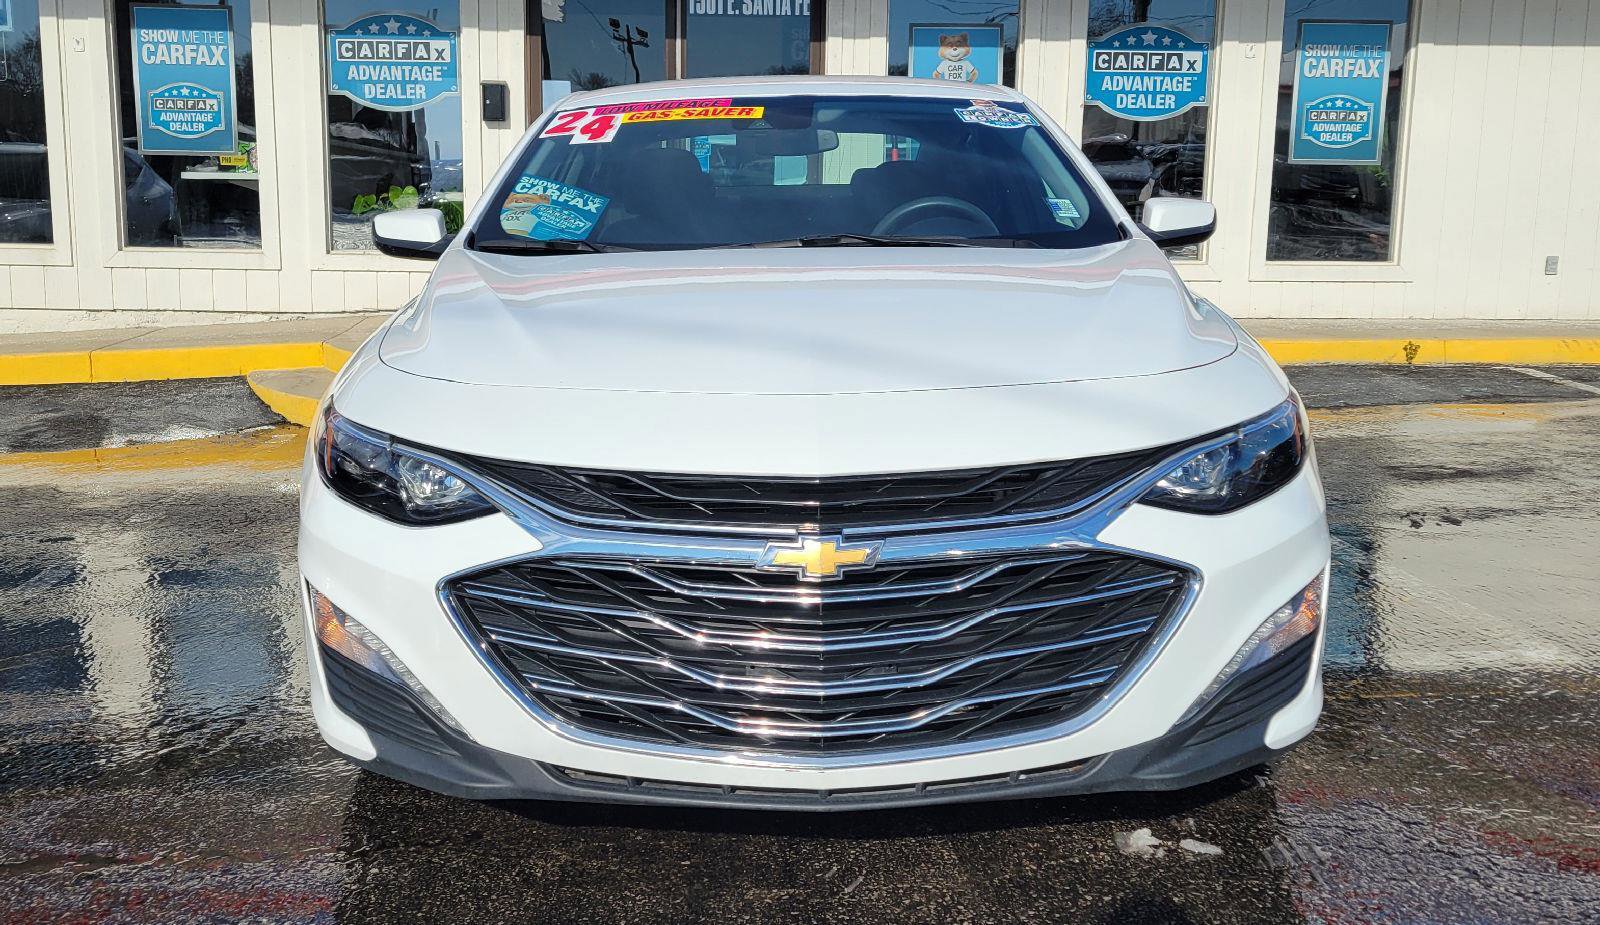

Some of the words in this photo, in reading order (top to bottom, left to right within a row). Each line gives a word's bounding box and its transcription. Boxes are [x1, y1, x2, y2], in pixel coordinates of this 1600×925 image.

[727, 0, 739, 15] E.
[742, 0, 792, 15] SANTA
[794, 0, 811, 16] FE
[140, 29, 178, 43] SHOW
[182, 32, 200, 43] ME
[202, 31, 224, 44] THE
[142, 43, 227, 66] CARFAX
[339, 42, 447, 62] CARFAX
[1305, 44, 1340, 57] SHOW
[1343, 44, 1360, 58] ME
[1363, 45, 1382, 58] THE
[1097, 53, 1198, 72] CARFAX
[1303, 58, 1381, 78] CARFAX
[348, 65, 443, 82] ADVANTAGE
[948, 72, 963, 80] FOX
[1101, 75, 1192, 92] ADVANTAGE
[364, 84, 427, 99] DEALER
[156, 98, 217, 111] CARFAX
[642, 99, 726, 111] MILEAGE
[1116, 93, 1176, 109] DEALER
[160, 113, 214, 122] ADVANTAGE
[1310, 110, 1367, 122] CARFAX
[170, 122, 205, 132] DEALER
[544, 111, 616, 142] 24
[1312, 123, 1363, 132] ADVANTAGE
[1320, 133, 1353, 142] DEALER
[515, 182, 601, 213] CARFAX
[519, 176, 560, 190] SHOW
[561, 186, 581, 196] ME
[583, 193, 604, 206] THE
